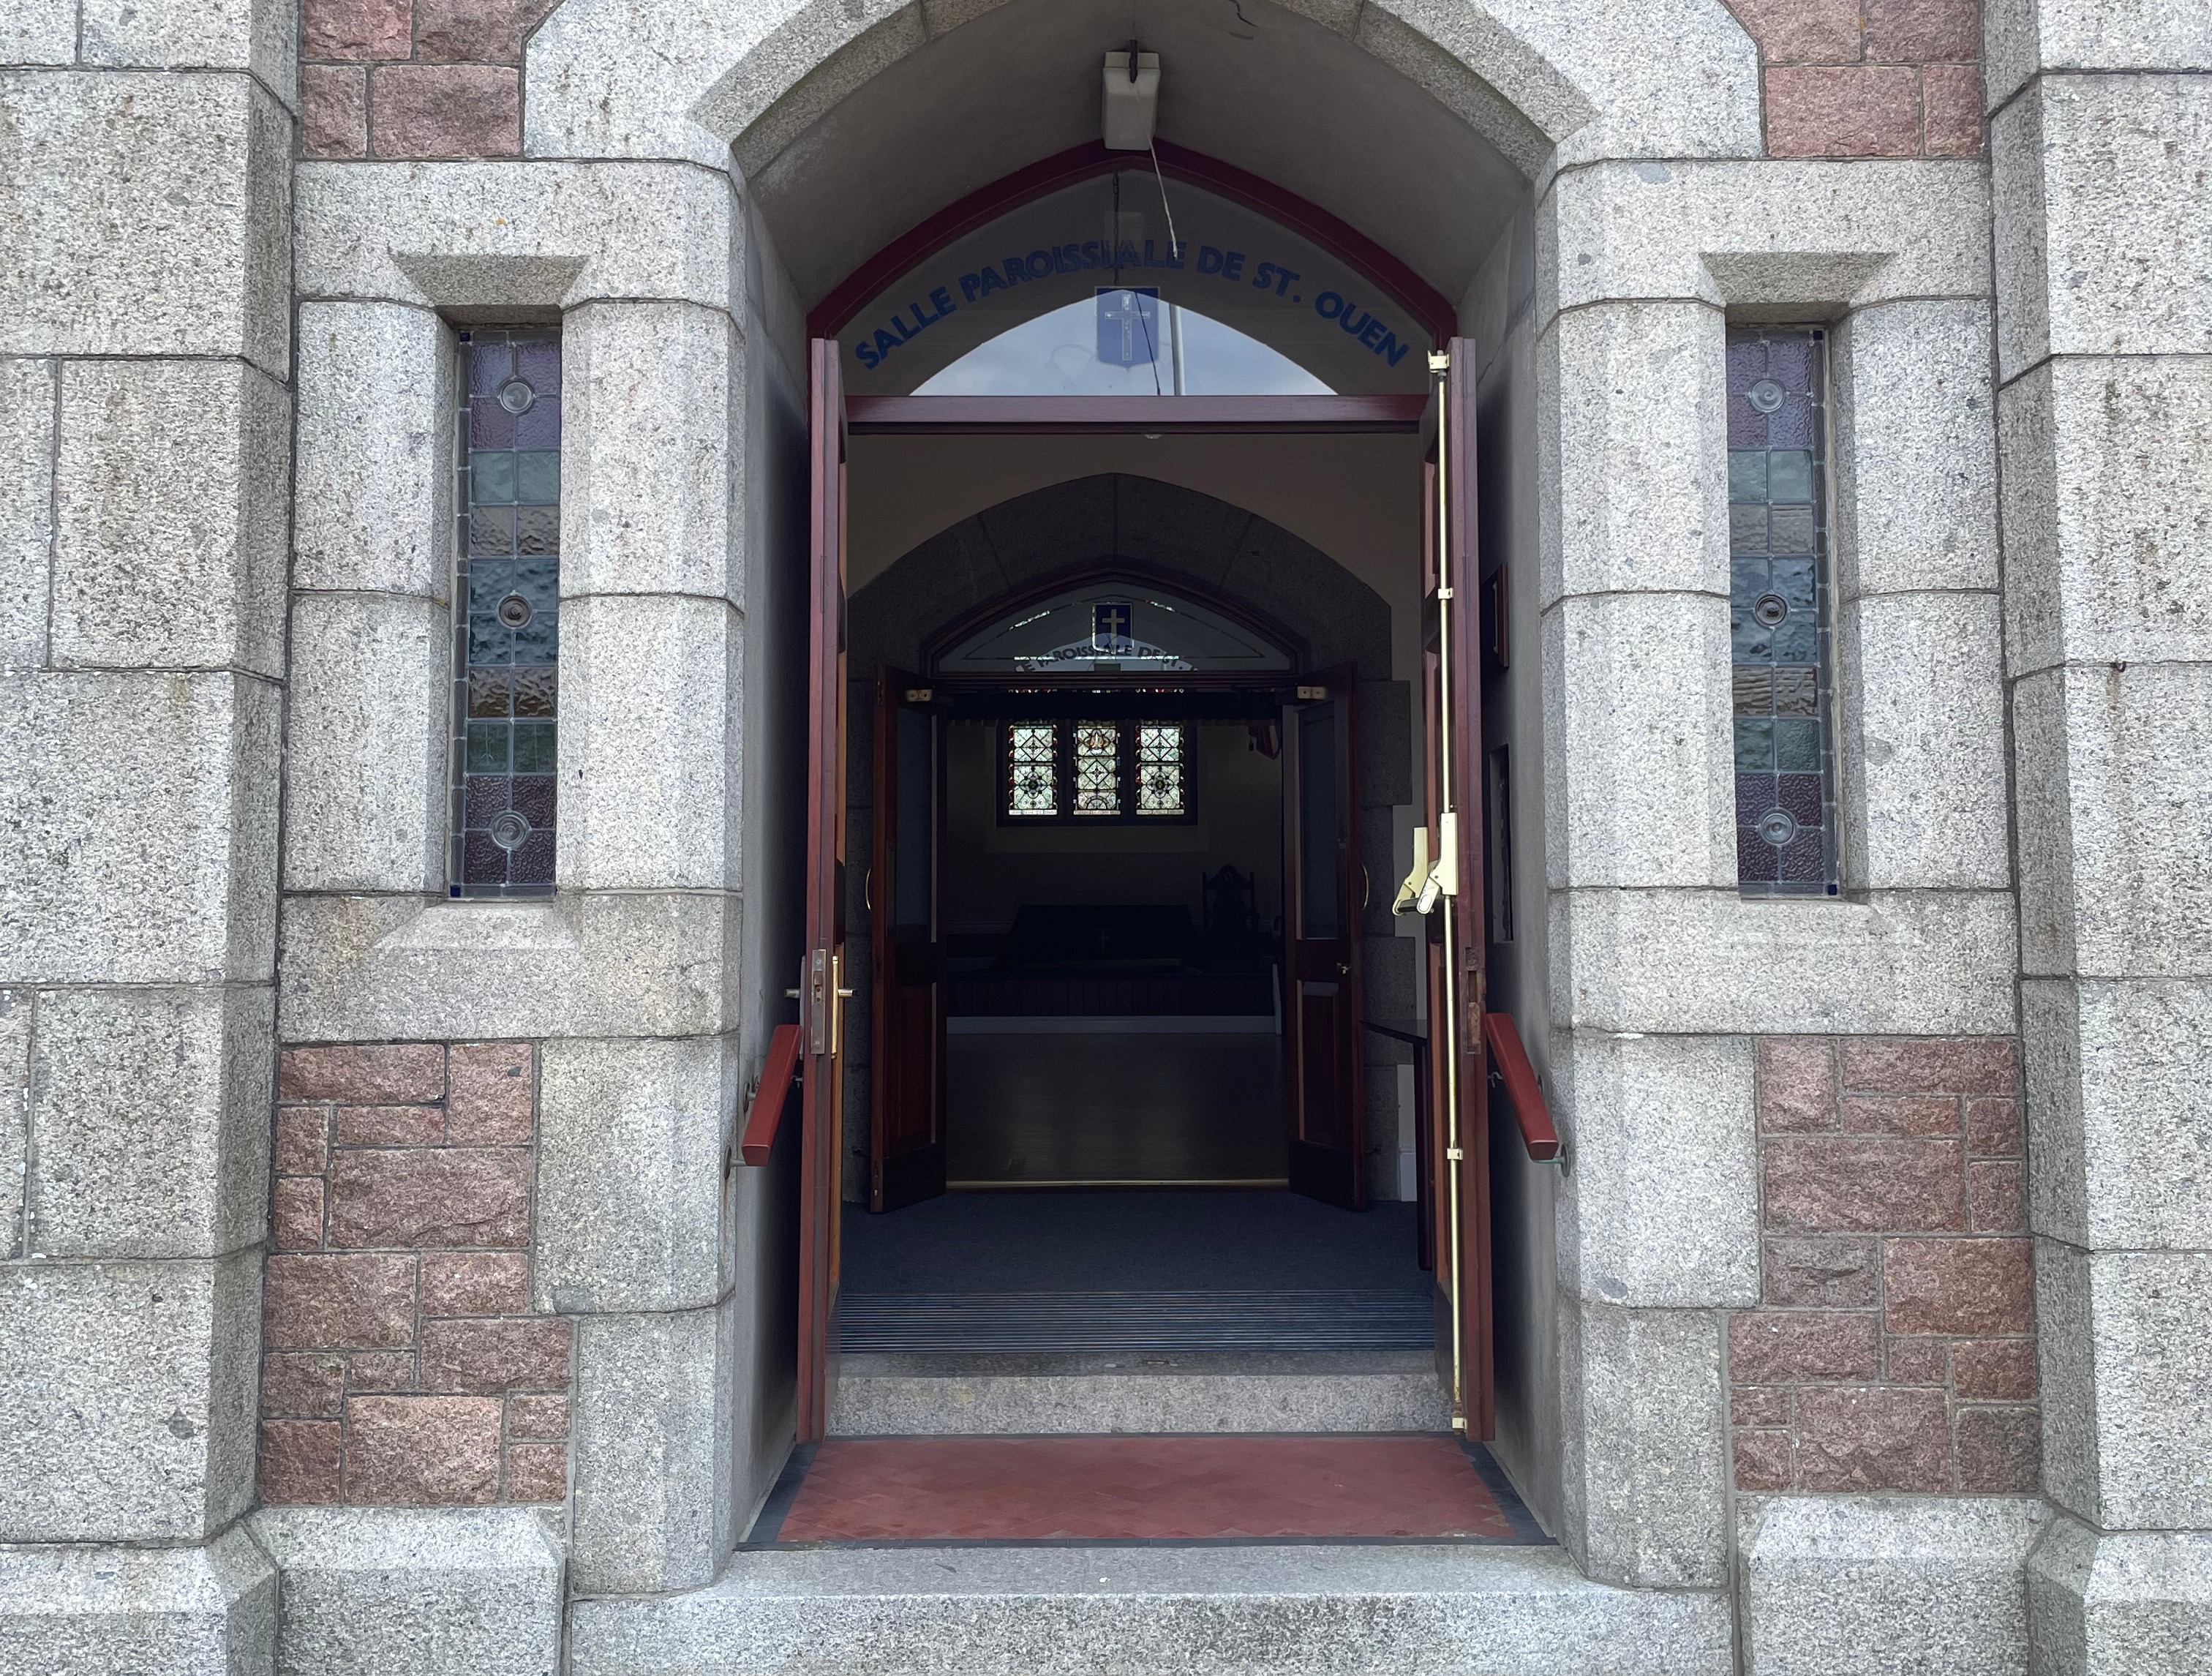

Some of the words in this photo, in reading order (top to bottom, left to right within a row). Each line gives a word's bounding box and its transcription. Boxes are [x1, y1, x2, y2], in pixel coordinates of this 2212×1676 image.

[855, 285, 958, 370] SALLE
[958, 240, 1186, 303] PAROISSIALE
[1196, 244, 1246, 282] DE
[1252, 261, 1301, 303] ST.
[1314, 290, 1410, 369] OUEN
